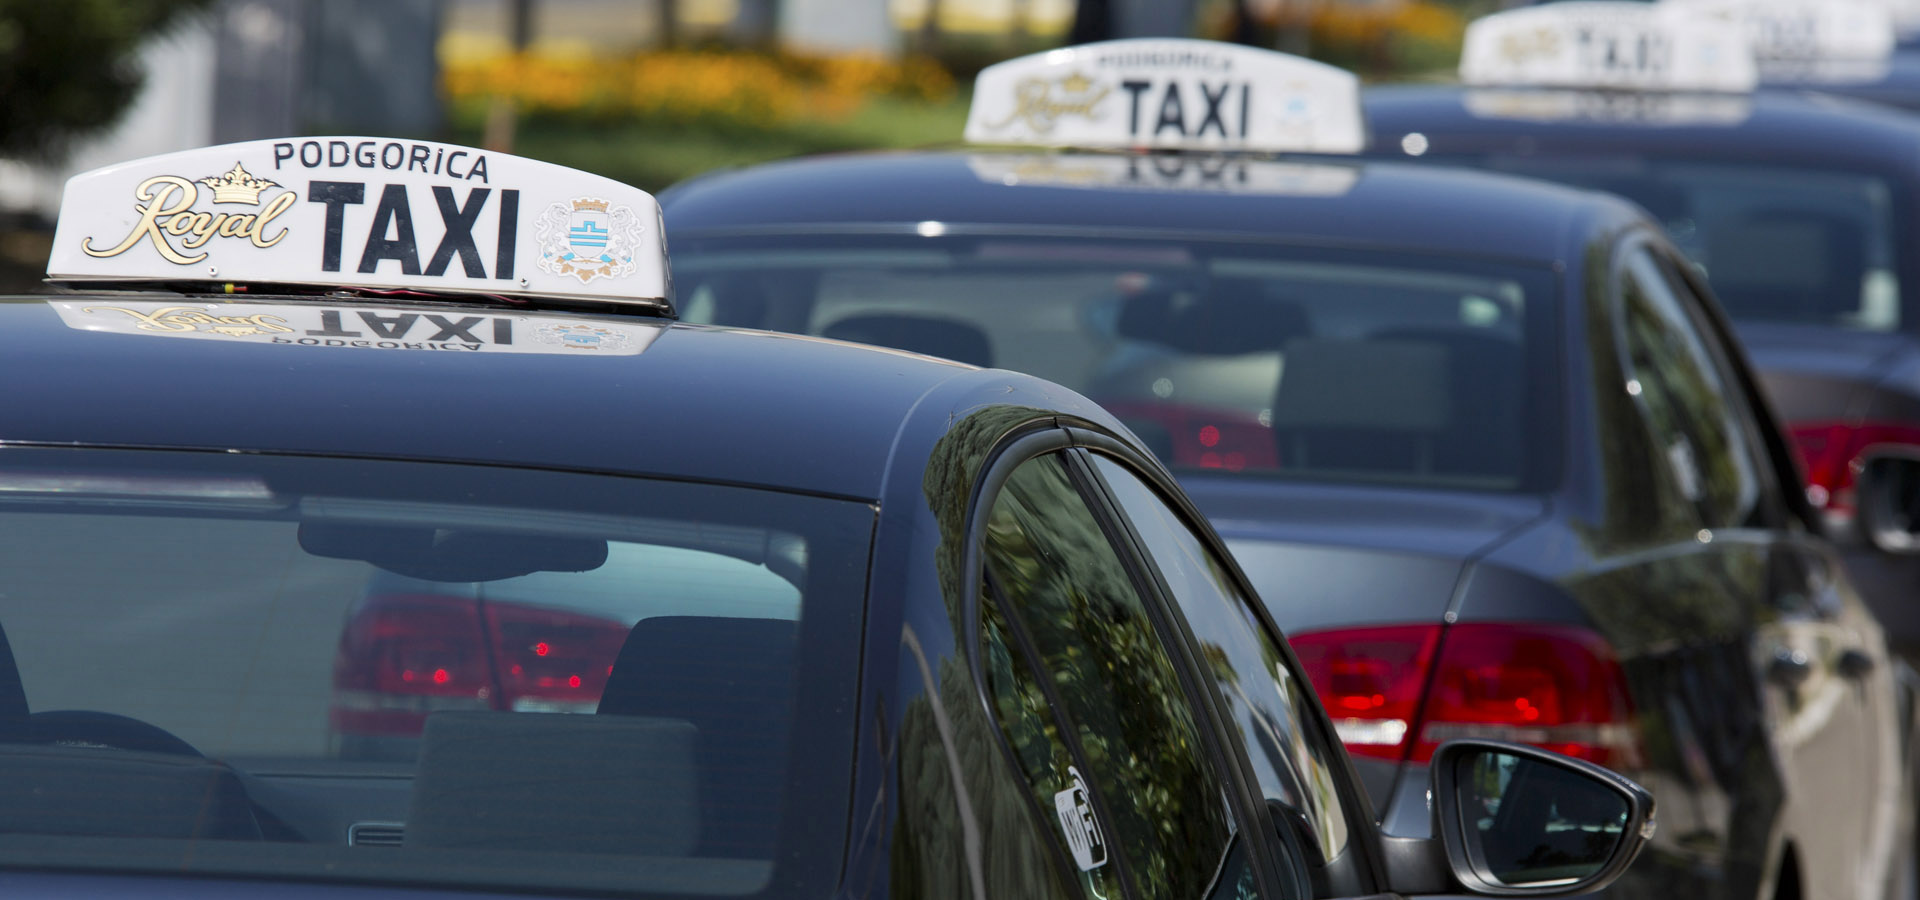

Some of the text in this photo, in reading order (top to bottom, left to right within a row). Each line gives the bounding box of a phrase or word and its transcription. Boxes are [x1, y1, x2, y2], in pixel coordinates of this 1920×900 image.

[1121, 80, 1249, 138] TAXI
[273, 140, 489, 184] PODGORICA
[81, 174, 520, 280] Royal TAXI
